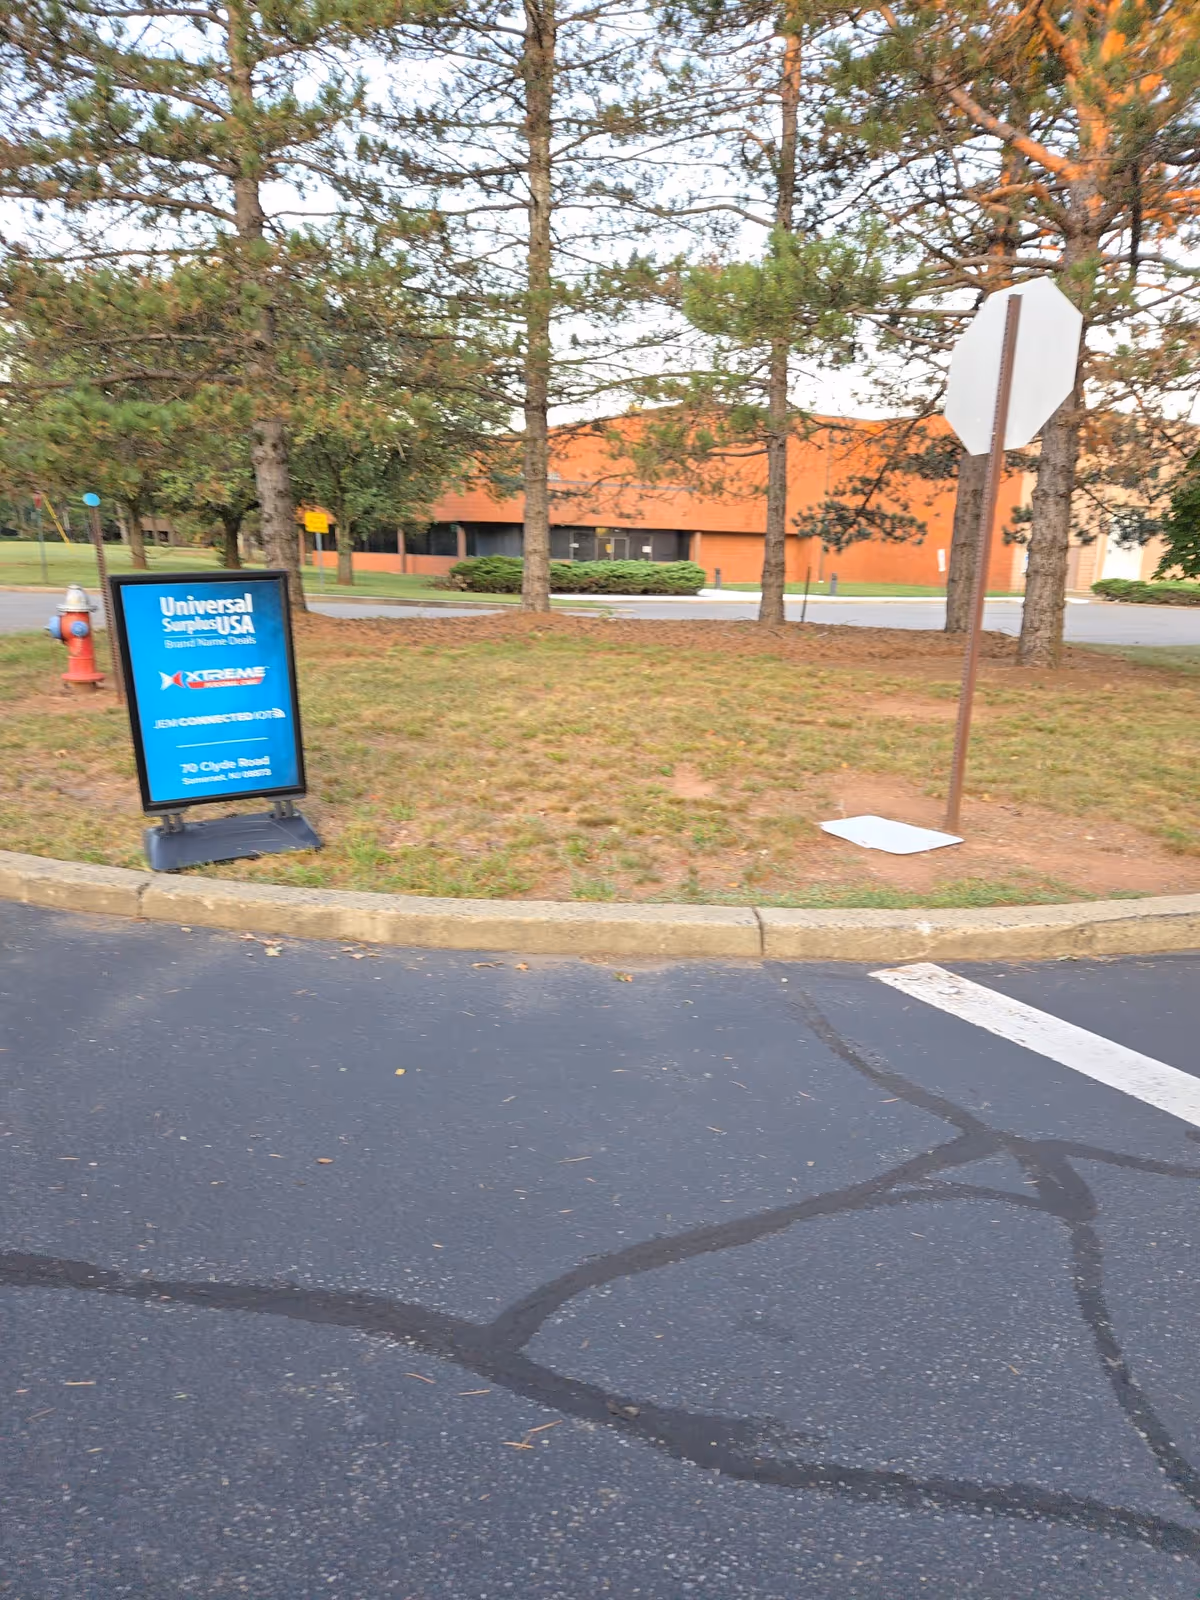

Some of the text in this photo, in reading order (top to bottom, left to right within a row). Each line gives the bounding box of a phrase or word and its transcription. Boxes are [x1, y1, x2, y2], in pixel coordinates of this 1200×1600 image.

[159, 593, 253, 616] Universal
[164, 634, 257, 649] Brand Name Deals
[184, 667, 266, 682] XTREME
[200, 760, 236, 772] Clyde
[237, 756, 270, 767] Road
